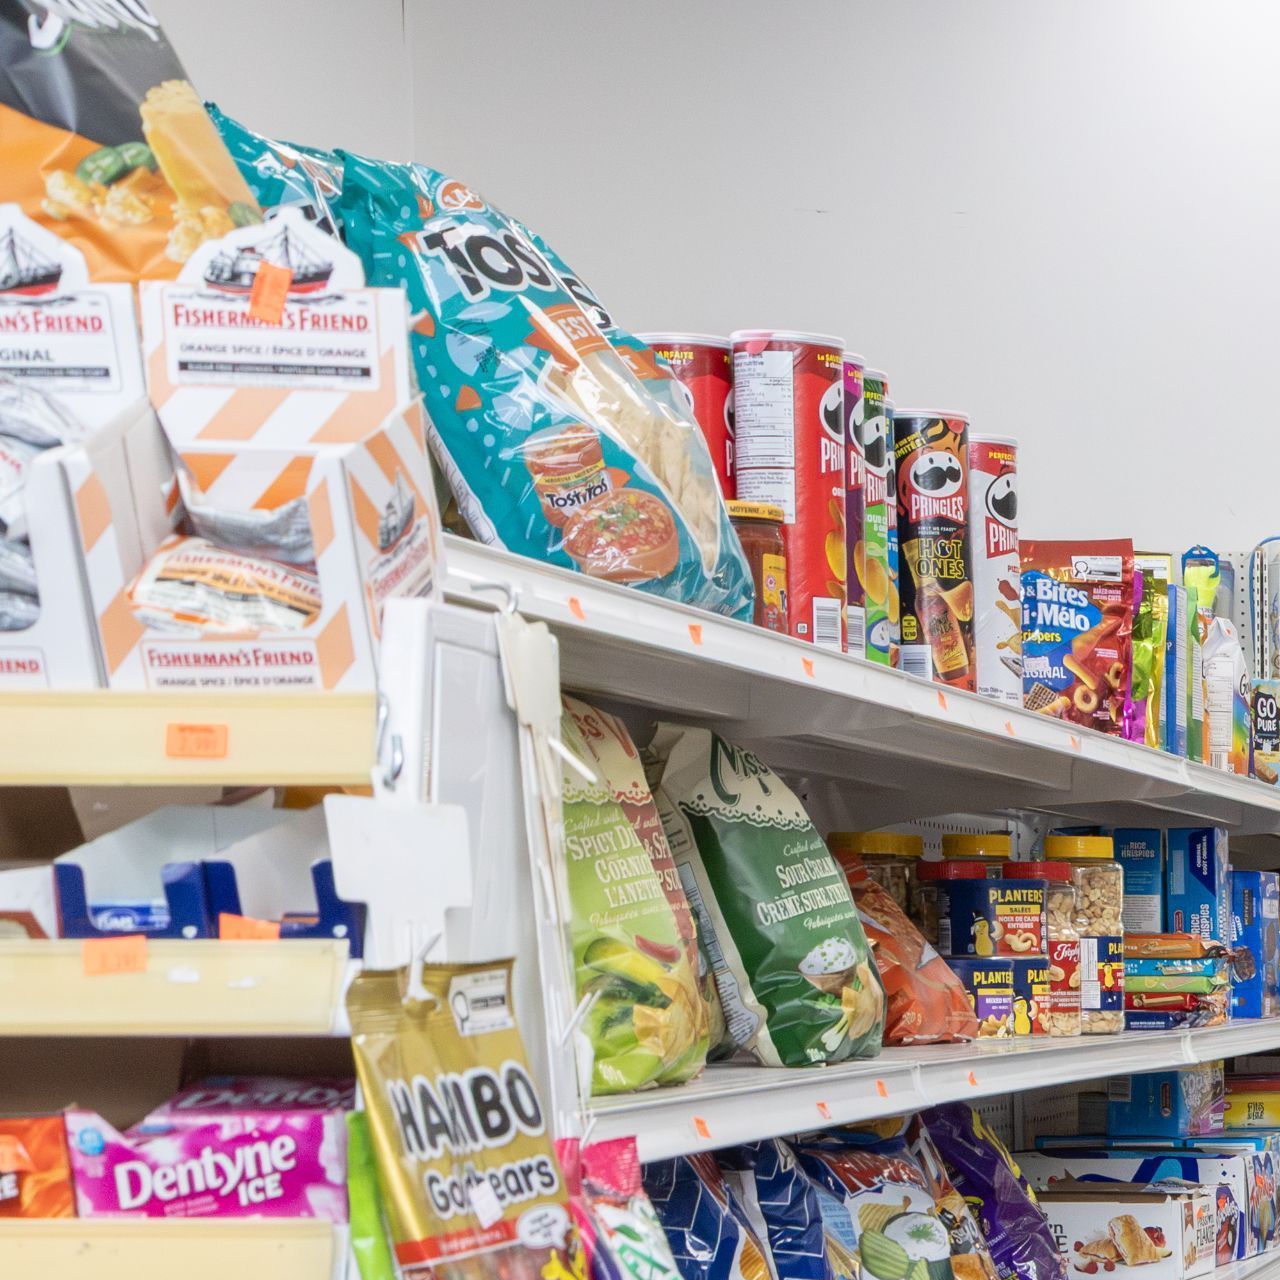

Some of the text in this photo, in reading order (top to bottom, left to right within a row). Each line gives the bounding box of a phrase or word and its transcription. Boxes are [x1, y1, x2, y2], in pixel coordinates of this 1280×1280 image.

[300, 308, 369, 331] FRIEND
[180, 343, 228, 355] ORANGE
[231, 344, 263, 355] SPICE
[912, 493, 964, 522] PRINGLES
[917, 559, 965, 578] ONES
[1036, 579, 1089, 607] Bites
[148, 648, 314, 668] FISHERMAN'S FRIEND
[1257, 698, 1276, 718] GO
[1257, 719, 1277, 732] PURE
[565, 825, 617, 861] SPICY
[776, 857, 805, 889] SOUR
[989, 889, 1043, 903] PLANTERS
[757, 895, 802, 927] CRÈME
[114, 1130, 297, 1211] Dentyne
[236, 1173, 285, 1207] ICE
